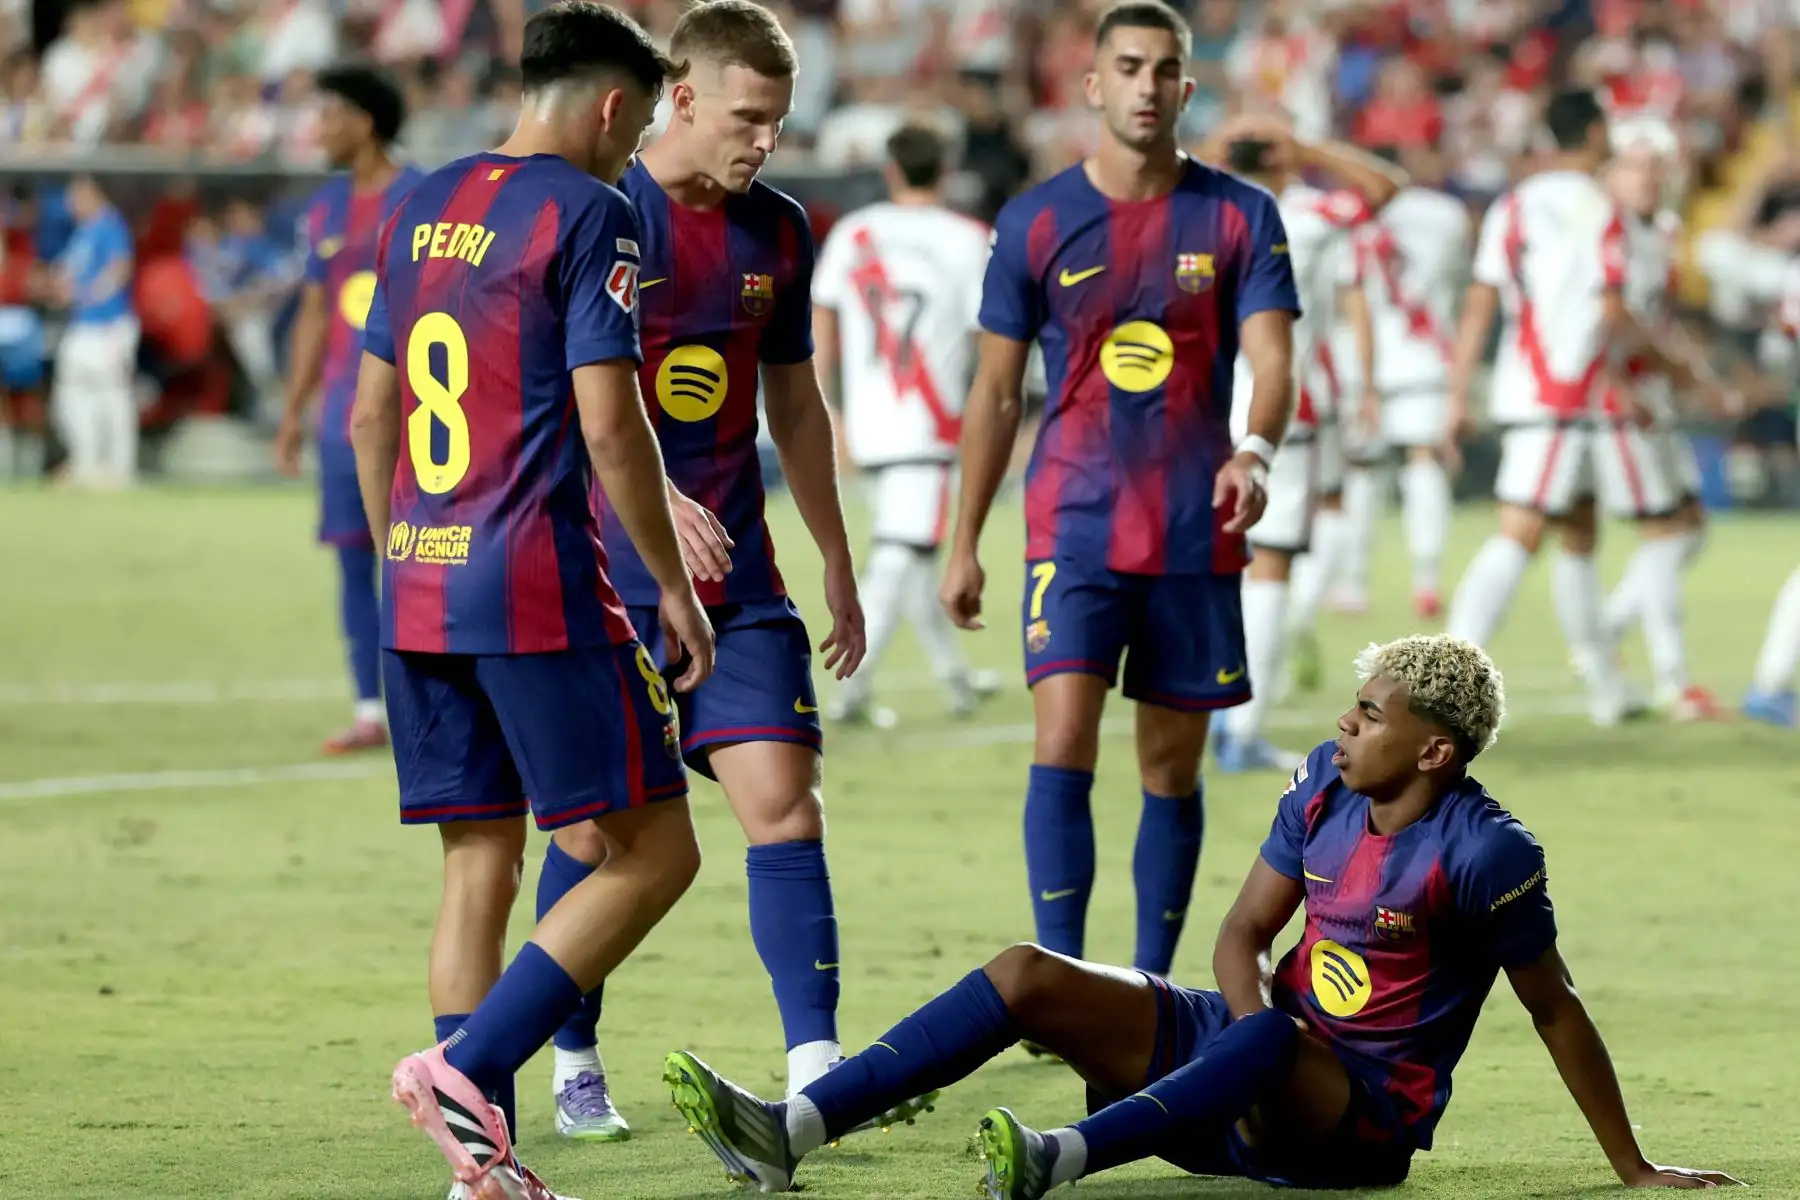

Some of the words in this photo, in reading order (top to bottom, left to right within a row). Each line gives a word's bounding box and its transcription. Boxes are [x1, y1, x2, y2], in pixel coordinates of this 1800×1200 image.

[412, 222, 496, 268] PEDRI
[407, 311, 470, 494] 8
[415, 541, 469, 557] ACNUR
[418, 526, 472, 541] UNHCR
[1031, 561, 1056, 619] 7
[635, 643, 672, 715] 8
